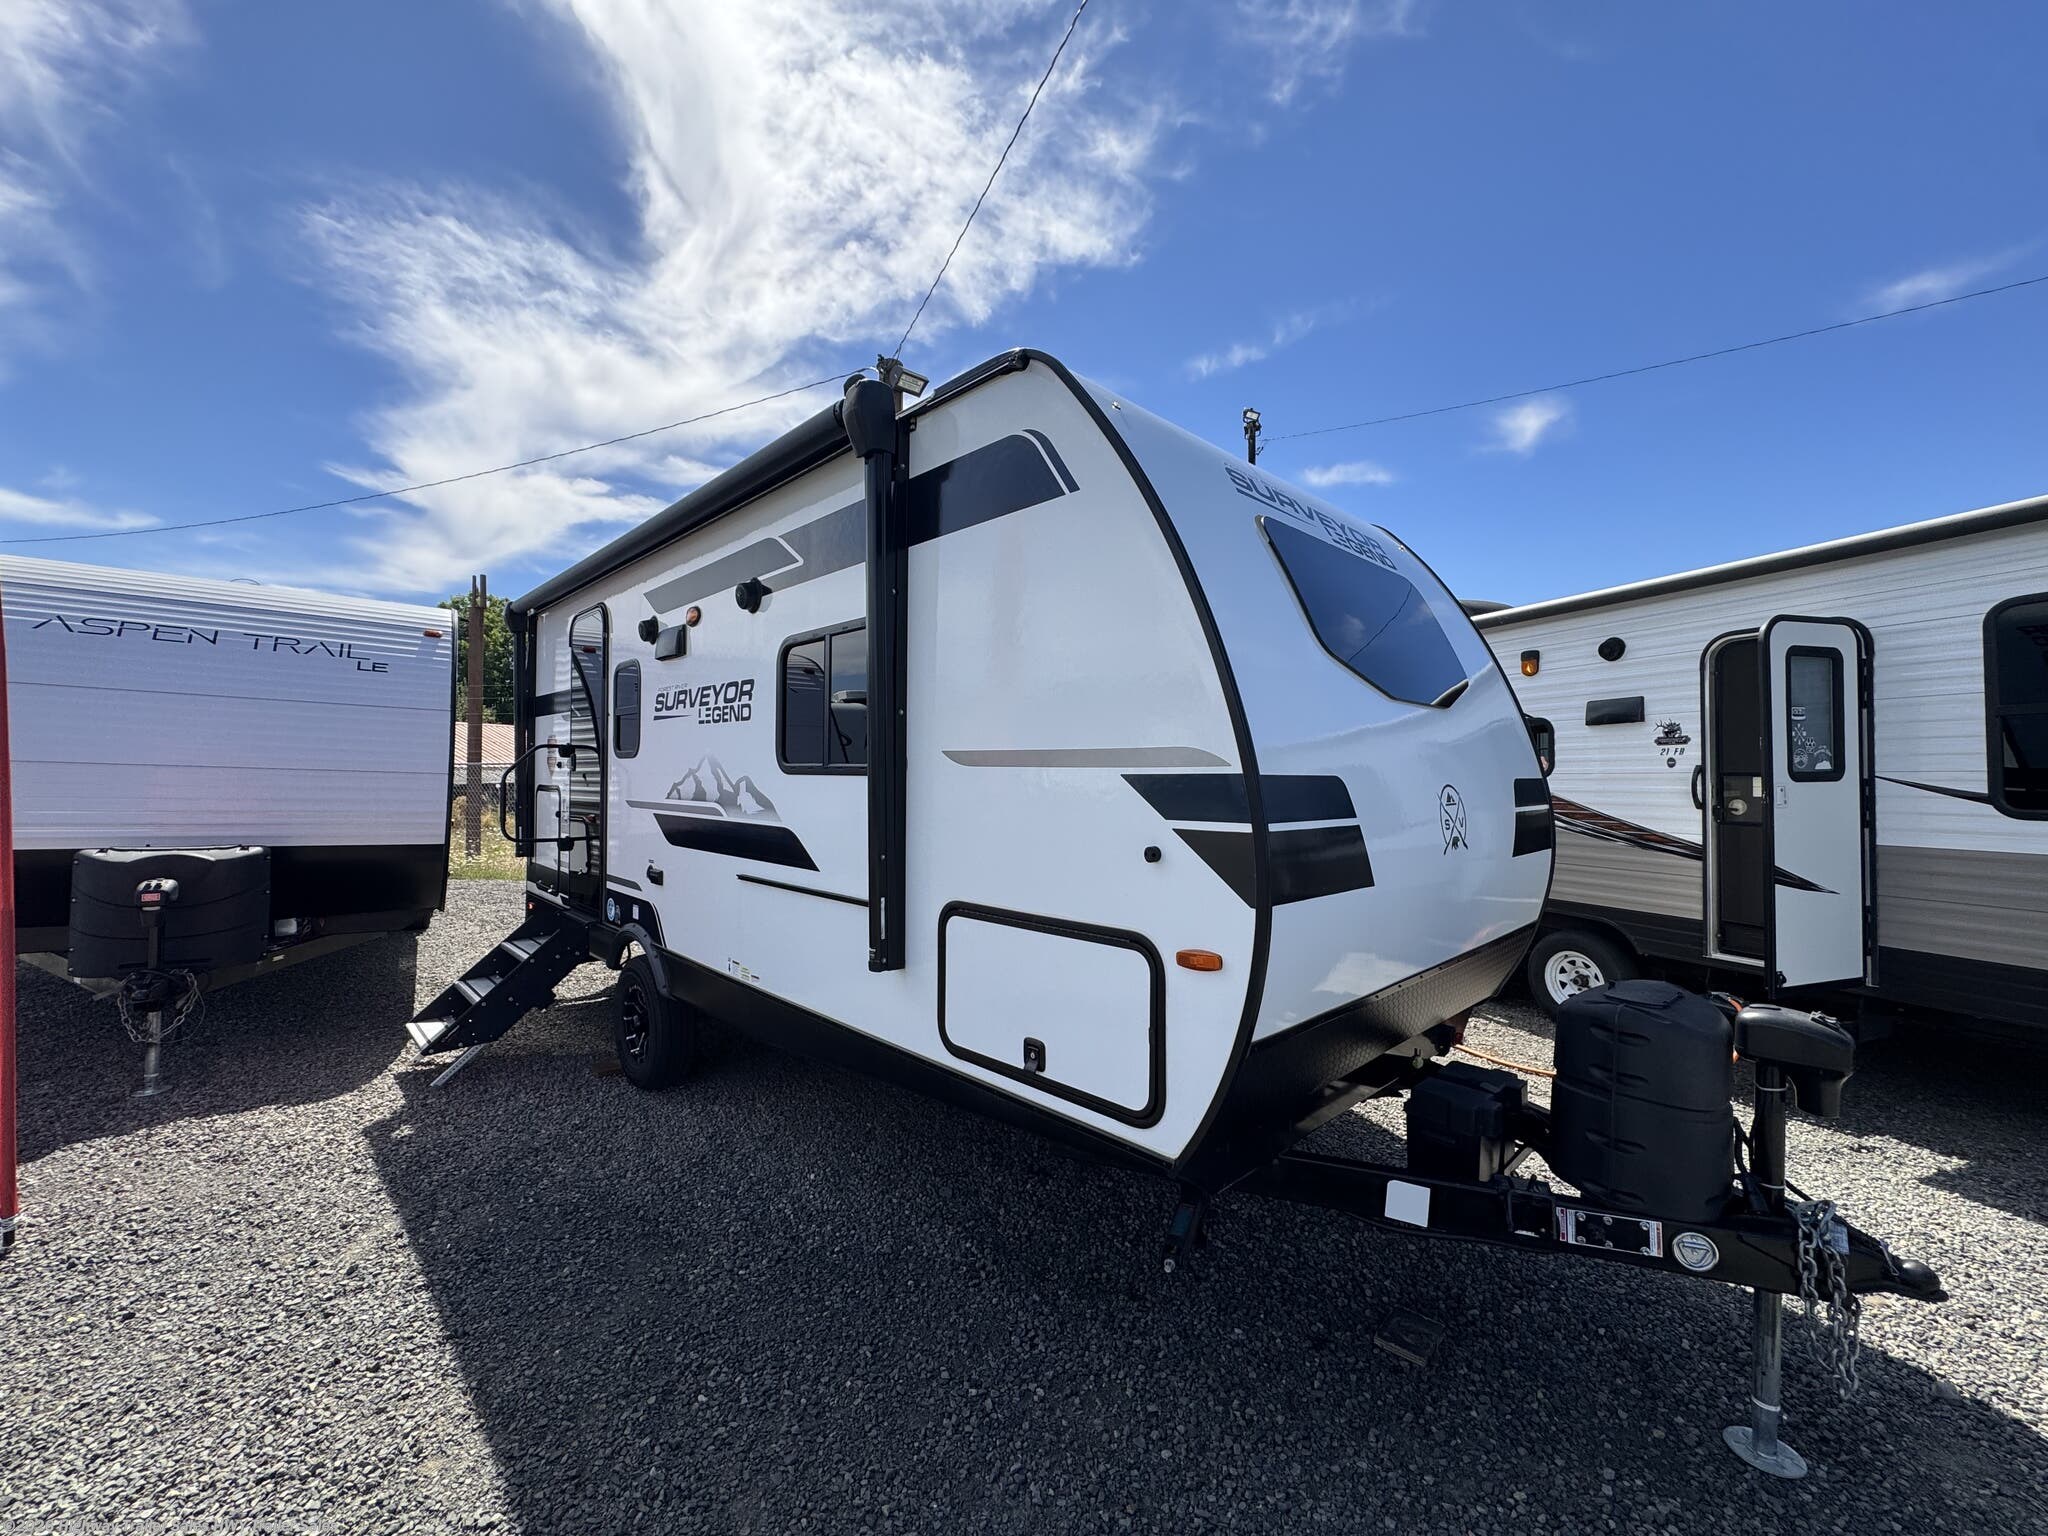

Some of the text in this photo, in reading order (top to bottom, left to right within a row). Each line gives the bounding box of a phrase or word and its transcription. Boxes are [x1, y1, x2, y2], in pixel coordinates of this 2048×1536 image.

[1225, 467, 1386, 555] SURVEYOR
[1324, 526, 1397, 570] LEGEND
[32, 615, 371, 660] ASPEN TRAIL
[357, 661, 389, 673] LE
[655, 679, 755, 712] SURVEYOR
[698, 703, 751, 725] LEGEND
[1660, 747, 1670, 756] 21
